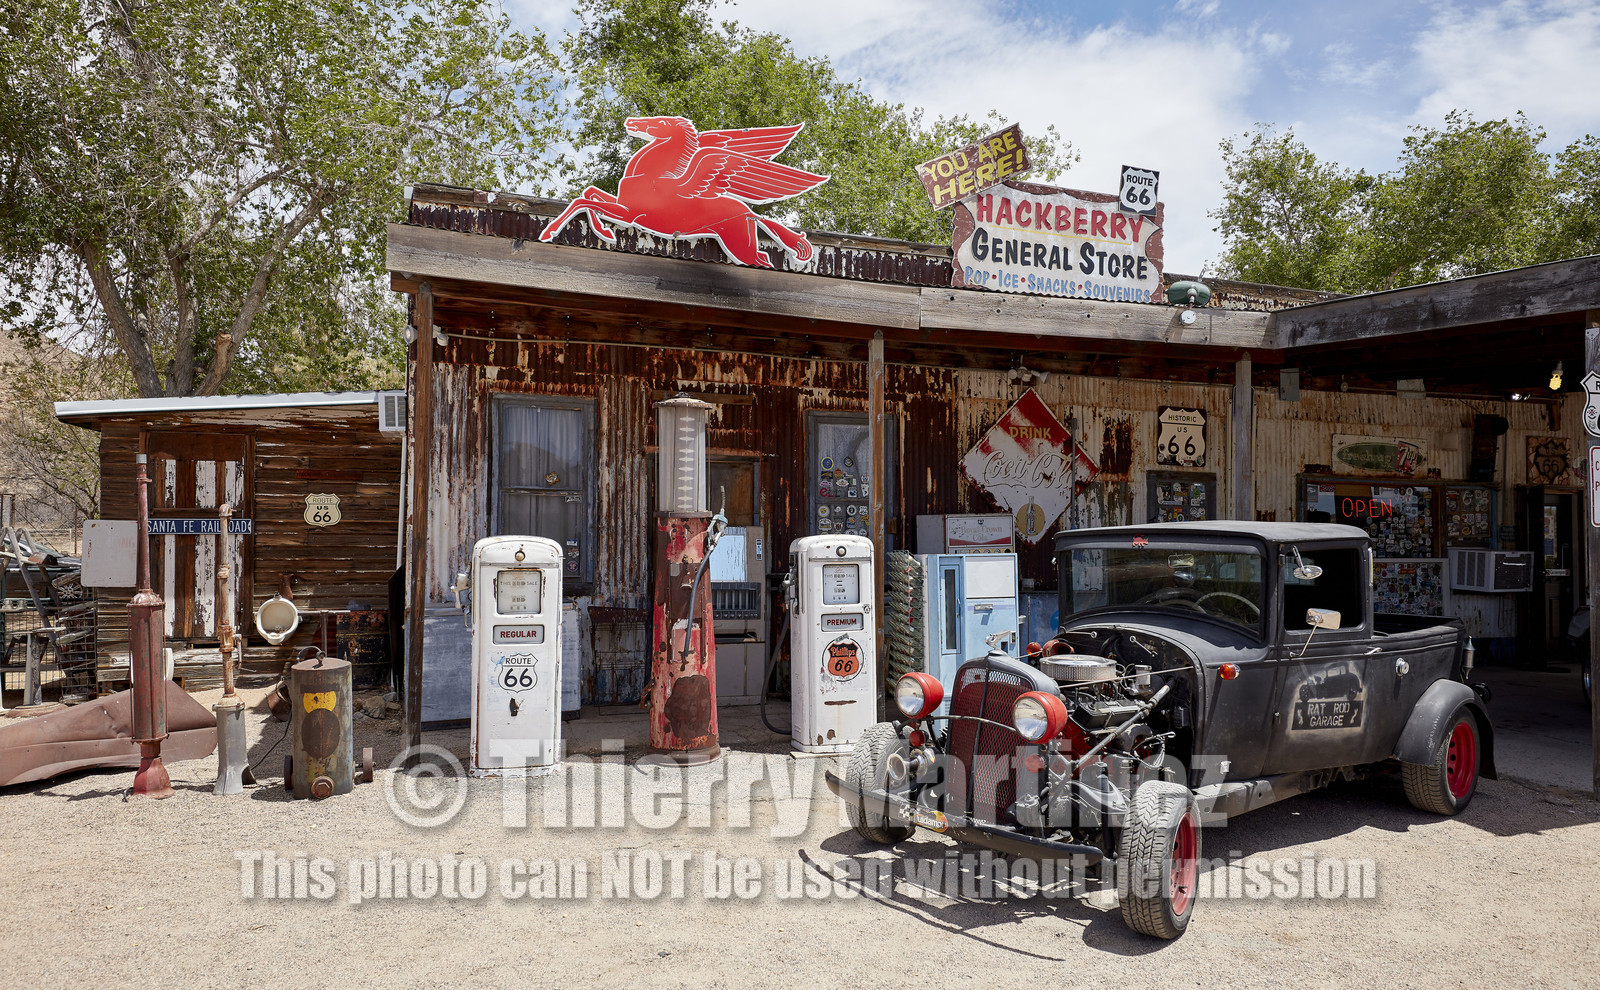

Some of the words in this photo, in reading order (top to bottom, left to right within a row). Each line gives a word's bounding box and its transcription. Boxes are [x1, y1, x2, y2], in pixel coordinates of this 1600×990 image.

[924, 152, 969, 183] YOU
[978, 131, 1018, 163] ARE
[933, 148, 1024, 205] HERE!
[1126, 174, 1154, 187] ROUTE
[1125, 186, 1151, 206] 66
[976, 194, 1144, 243] HACKBERRY
[971, 227, 1073, 272] GENERAL
[1079, 242, 1148, 280] STORE
[1168, 414, 1197, 422] HISTORIC
[1009, 426, 1052, 439] DRINK
[1168, 434, 1196, 456] 66
[1341, 497, 1393, 518] OPEN
[313, 511, 331, 523] 66
[147, 521, 176, 533] SANTA
[183, 521, 194, 533] FE
[201, 521, 247, 533] RAILOAD
[826, 618, 857, 626] PREMIUM
[830, 646, 856, 659] Phillips
[505, 657, 532, 665] ROUTE
[834, 659, 853, 673] 66
[504, 668, 533, 688] 66
[1307, 703, 1326, 715] RAT
[1333, 702, 1351, 714] ROD
[1310, 715, 1345, 727] GARAGE
